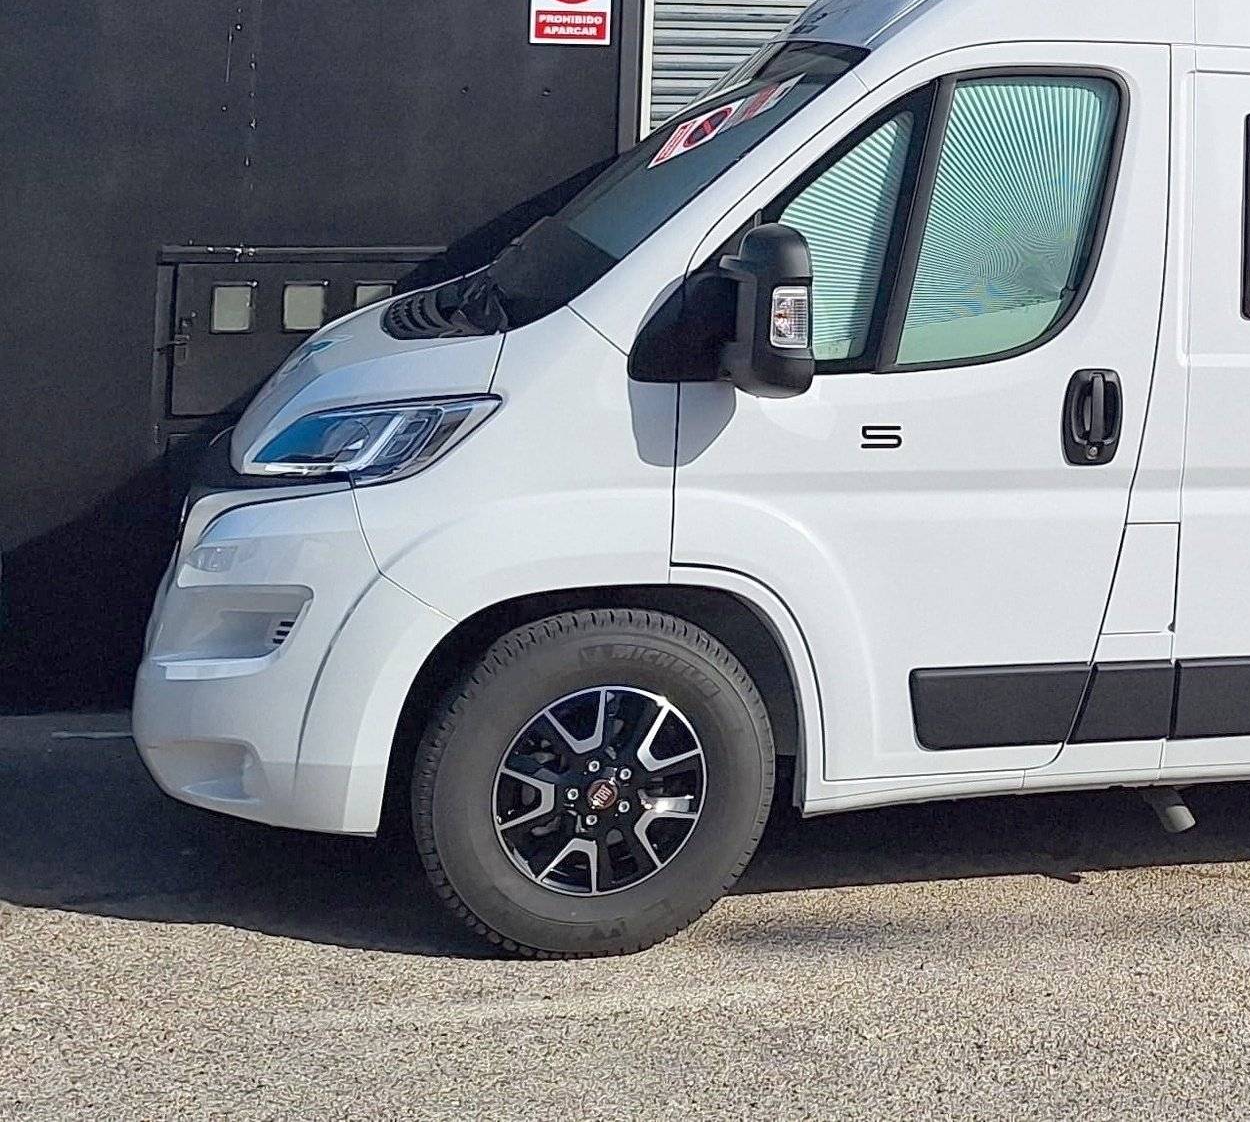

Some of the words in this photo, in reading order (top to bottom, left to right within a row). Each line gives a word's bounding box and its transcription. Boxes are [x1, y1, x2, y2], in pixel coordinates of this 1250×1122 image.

[538, 14, 603, 25] PROHIBIDO
[543, 26, 598, 36] APARCAR
[861, 425, 902, 449] S
